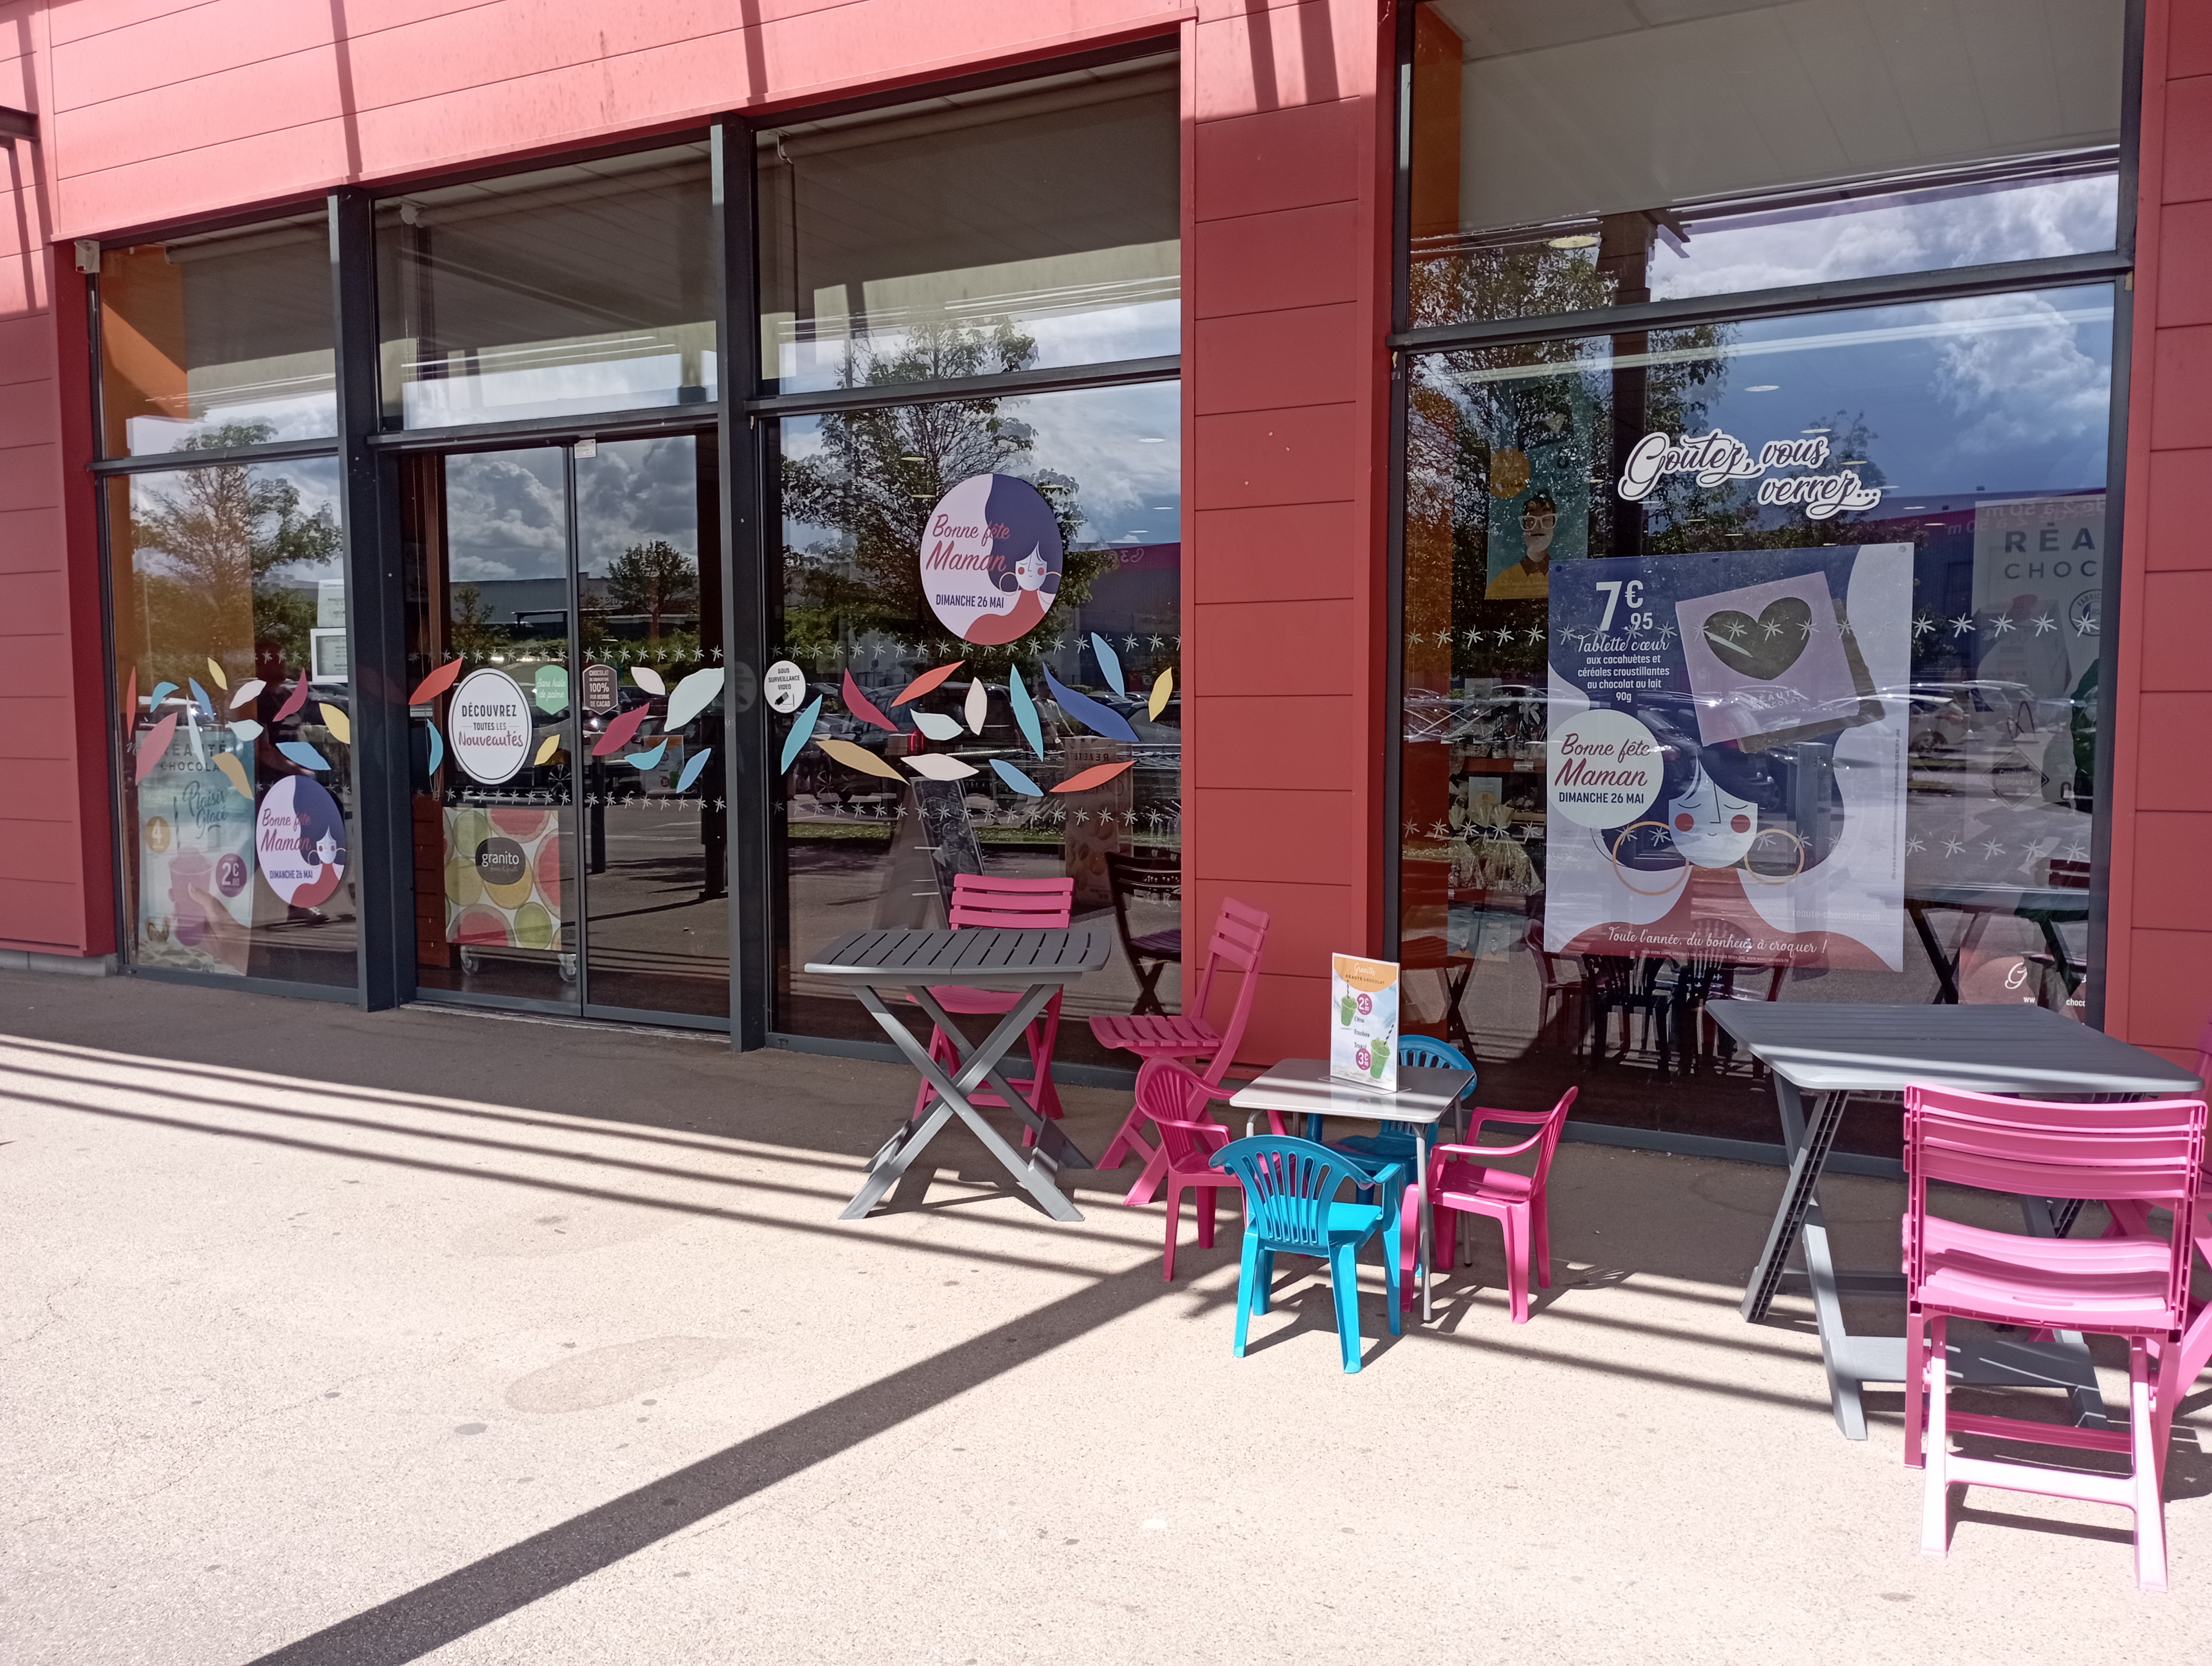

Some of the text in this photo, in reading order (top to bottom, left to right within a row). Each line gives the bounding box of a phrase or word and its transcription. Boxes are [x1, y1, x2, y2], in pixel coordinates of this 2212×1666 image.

[1763, 439, 1824, 465] vous
[933, 514, 1011, 547] Bonne fête
[925, 540, 1007, 571] Maman
[2004, 560, 2097, 580] CHOC
[936, 594, 1004, 608] DIMANCHE 26 MAI
[1578, 635, 1670, 652] Tablette cœur
[1603, 654, 1650, 664] cacahuètes
[1652, 655, 1661, 663] et
[1578, 667, 1670, 677] céréales croustillantes
[537, 678, 567, 688] Sans huile
[589, 682, 610, 693] 100%
[1599, 679, 1634, 689] chocolat
[1636, 680, 1647, 688] au
[1648, 678, 1662, 689] lait
[546, 691, 565, 702] palme
[1616, 692, 1632, 703] 90g
[462, 702, 517, 717] DÉCOUVREZ
[496, 722, 507, 731] LES
[459, 730, 524, 747] Nouveautés
[1561, 733, 1651, 764] Bonne fête
[1554, 758, 1648, 786] Maman
[1999, 770, 2033, 778] Catalogue
[182, 780, 228, 817] Plaisir
[1559, 792, 1644, 804] DIMANCHE 26 MAI
[262, 808, 292, 826] Bonne
[261, 828, 311, 852] Maman
[481, 851, 519, 867] granito
[269, 870, 313, 879] DIMANCHE 26 MAI
[1609, 926, 1637, 943] Toute
[1686, 932, 1703, 947] du
[1706, 933, 1754, 950] bonheur
[1757, 937, 1766, 950] à
[1770, 939, 1817, 958] croquer
